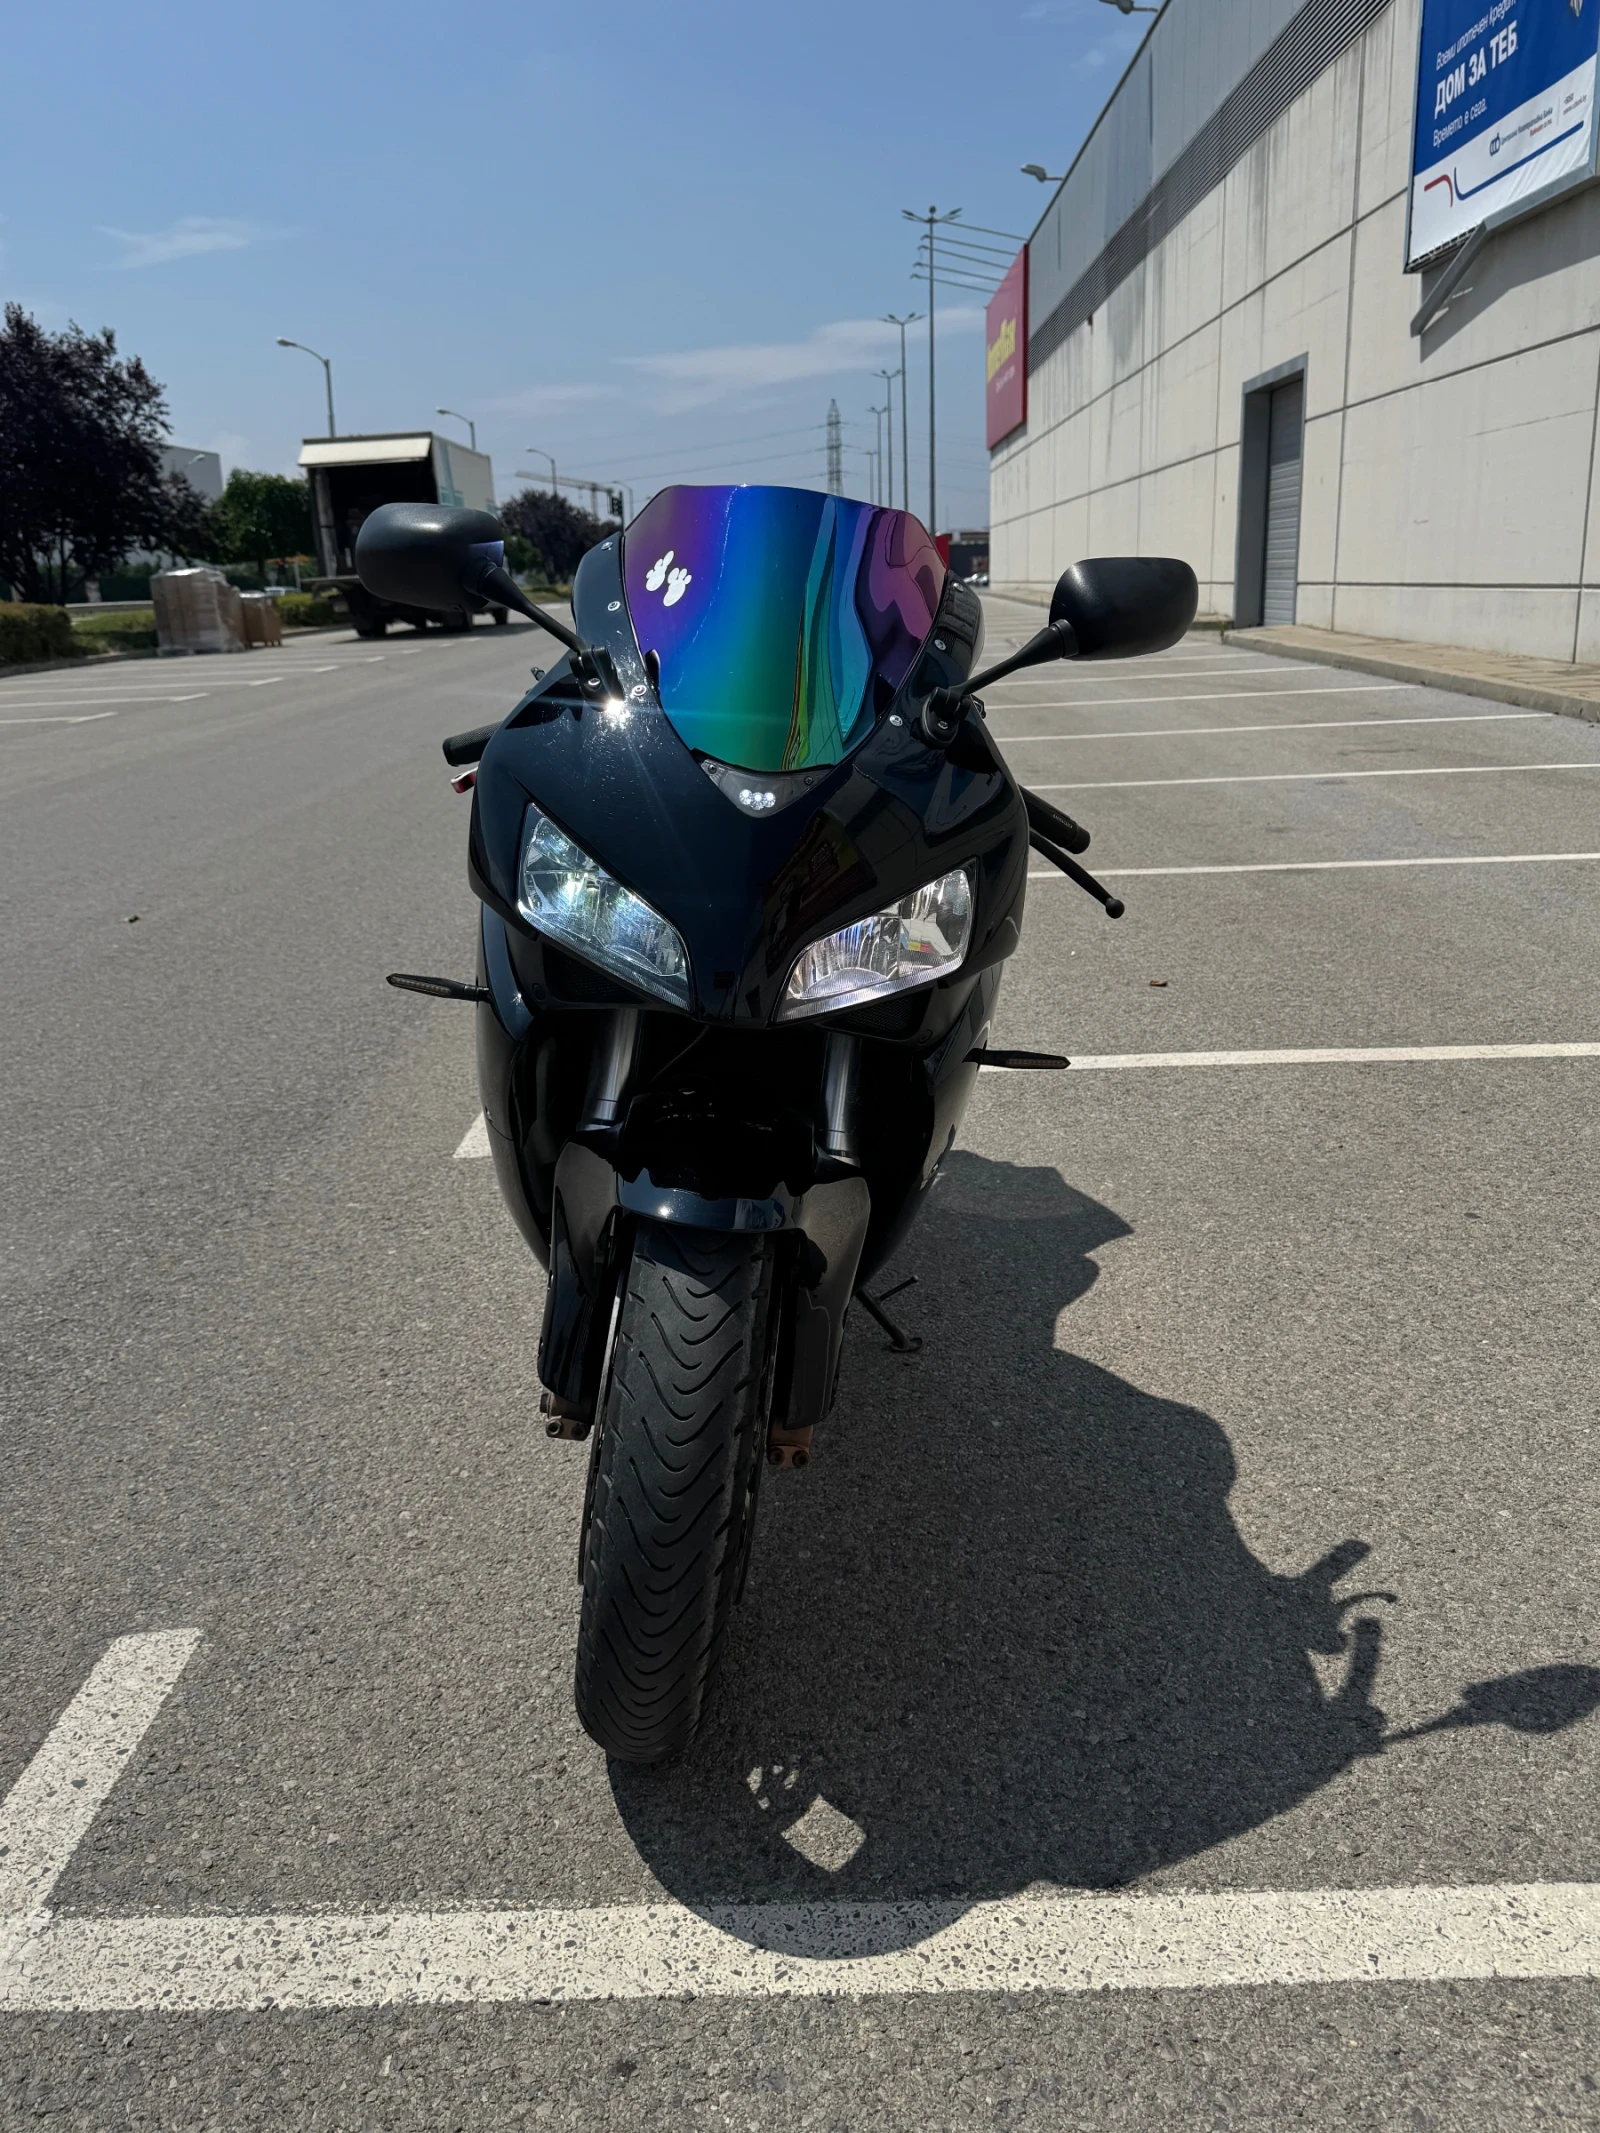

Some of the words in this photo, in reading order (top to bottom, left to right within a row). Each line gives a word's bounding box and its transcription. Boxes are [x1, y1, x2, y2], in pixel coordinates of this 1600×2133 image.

[1436, 42, 1457, 71] Вземи
[1456, 14, 1489, 54] ипотечен
[1434, 62, 1466, 120] ДОМ
[1468, 46, 1487, 87] ЗА
[1433, 115, 1463, 149] Времето
[1464, 110, 1470, 125] е
